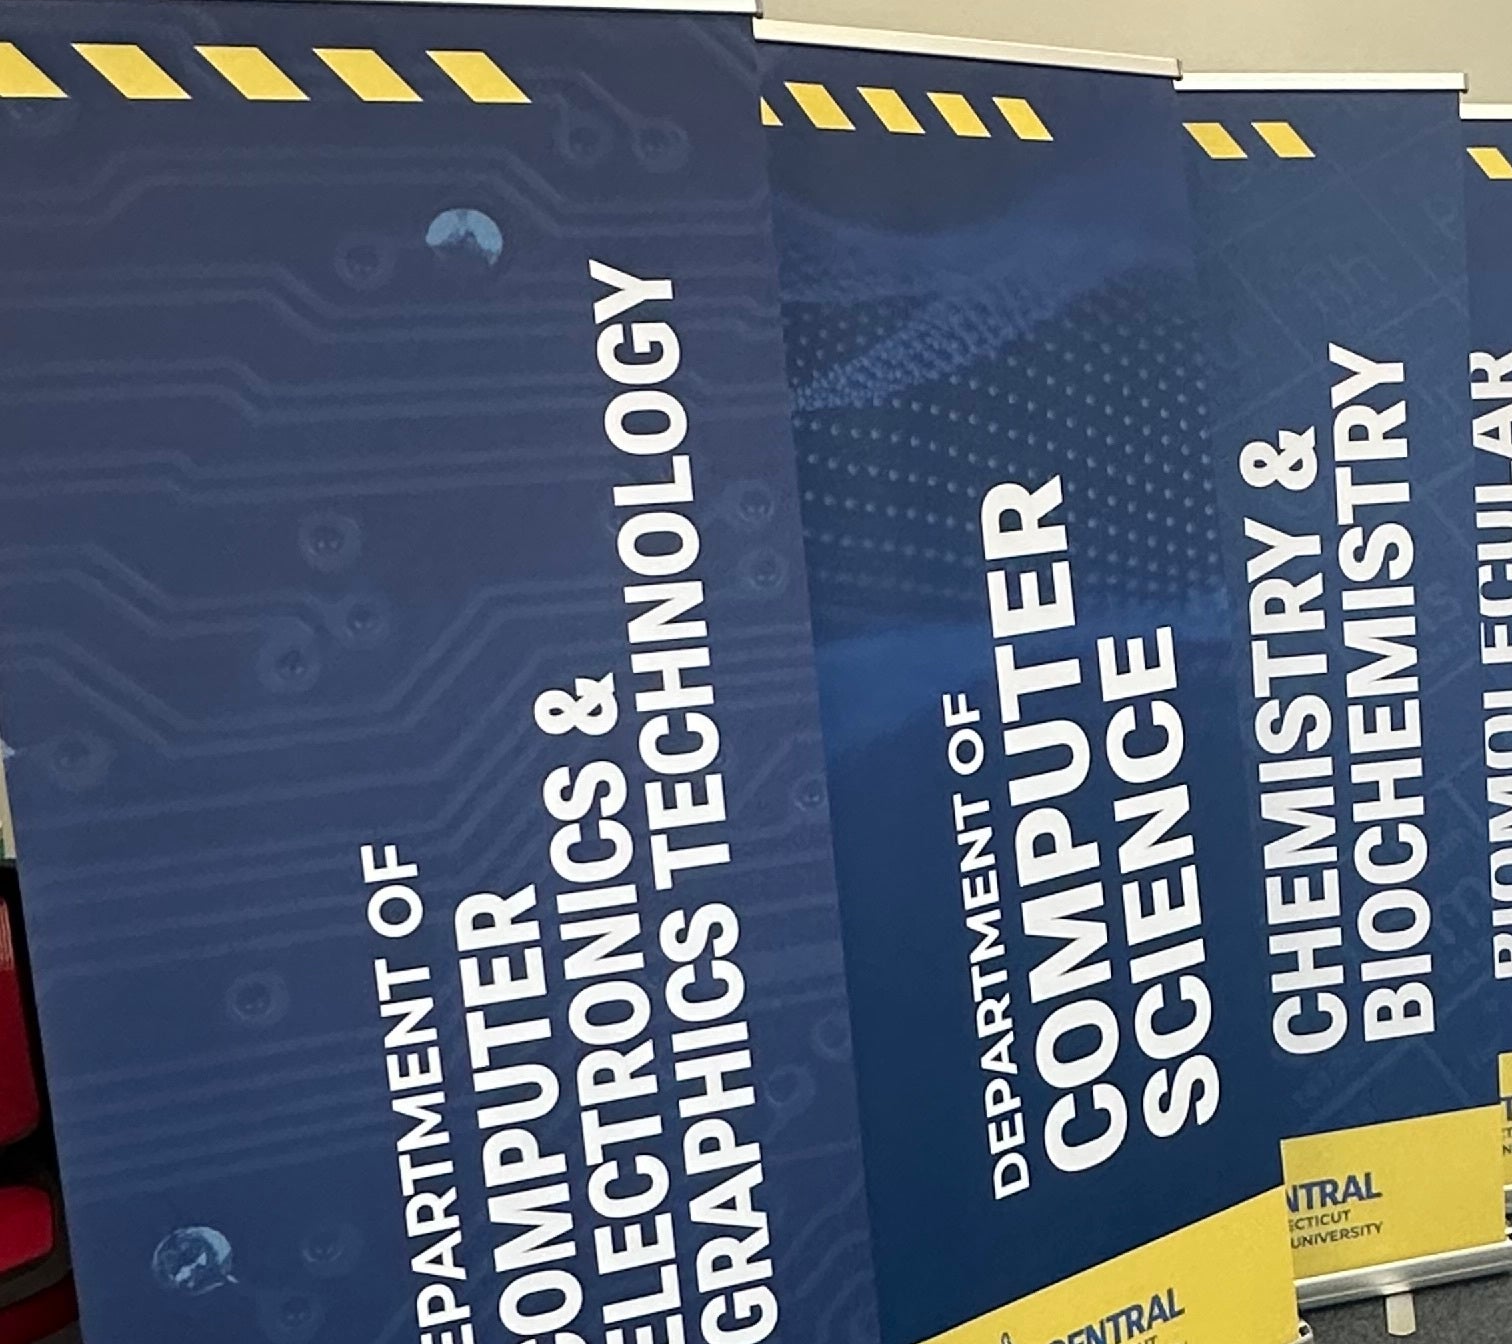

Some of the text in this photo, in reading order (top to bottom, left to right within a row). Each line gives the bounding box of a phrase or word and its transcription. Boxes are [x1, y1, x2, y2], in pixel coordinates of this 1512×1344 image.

[533, 672, 618, 736] &
[588, 259, 731, 891] TECHNOLOGY
[980, 474, 1128, 1172] COMPUTER
[1239, 425, 1348, 1054] CHEMISTRY &
[1328, 342, 1435, 1042] BIOCHEMISTRY
[360, 844, 424, 938] OF
[942, 693, 1030, 1200] DEPARTMENT OF
[1096, 626, 1220, 1138] SCIENCE
[1285, 1172, 1383, 1213] NTRAL
[1291, 1220, 1383, 1249] UNIVERSITY
